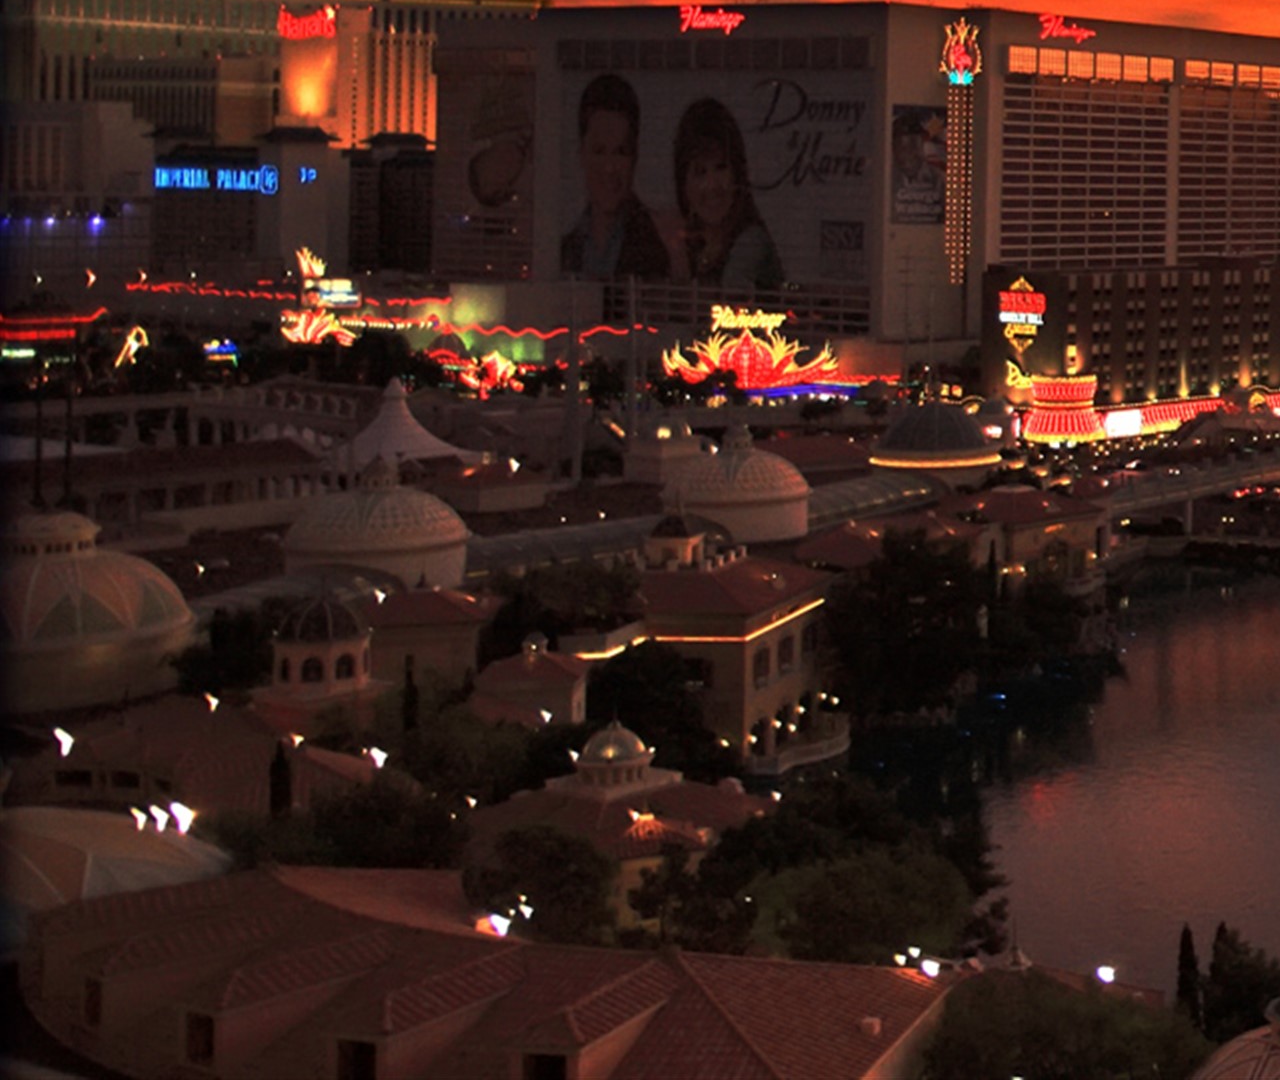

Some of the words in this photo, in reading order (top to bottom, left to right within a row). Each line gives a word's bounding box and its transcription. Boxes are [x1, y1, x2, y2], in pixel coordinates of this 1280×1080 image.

[679, 5, 746, 35] Flamingo
[752, 78, 866, 132] Donny
[750, 132, 866, 191] Marie
[155, 167, 210, 189] IMPERIAL
[711, 305, 786, 336] Flamingo
